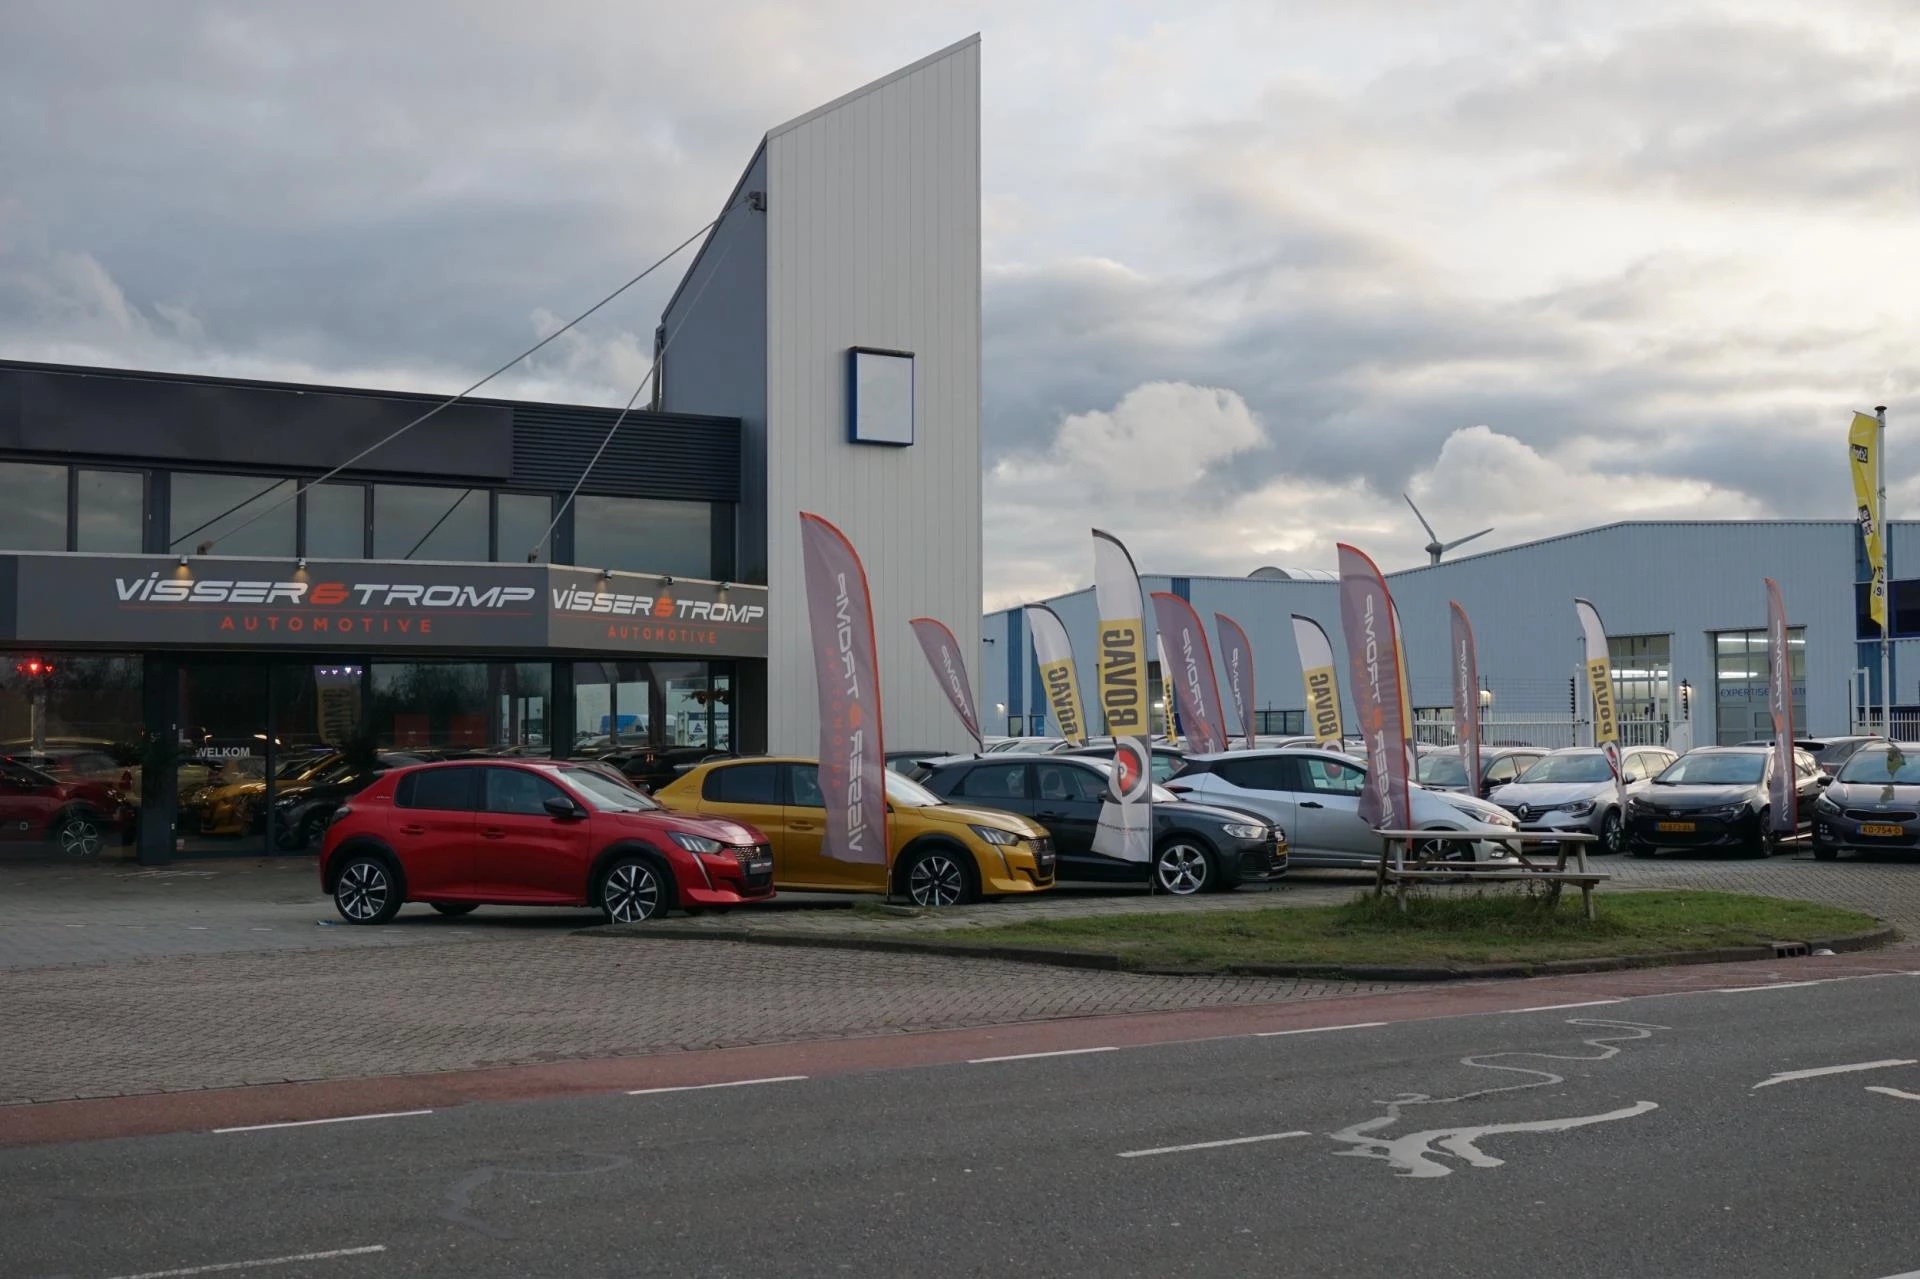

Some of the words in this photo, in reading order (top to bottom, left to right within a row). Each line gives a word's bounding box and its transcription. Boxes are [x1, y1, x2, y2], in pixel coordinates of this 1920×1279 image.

[219, 616, 432, 632] AUTOMOTIVE
[607, 626, 718, 643] AUTOMOTIVE
[196, 747, 250, 758] WELKOM
